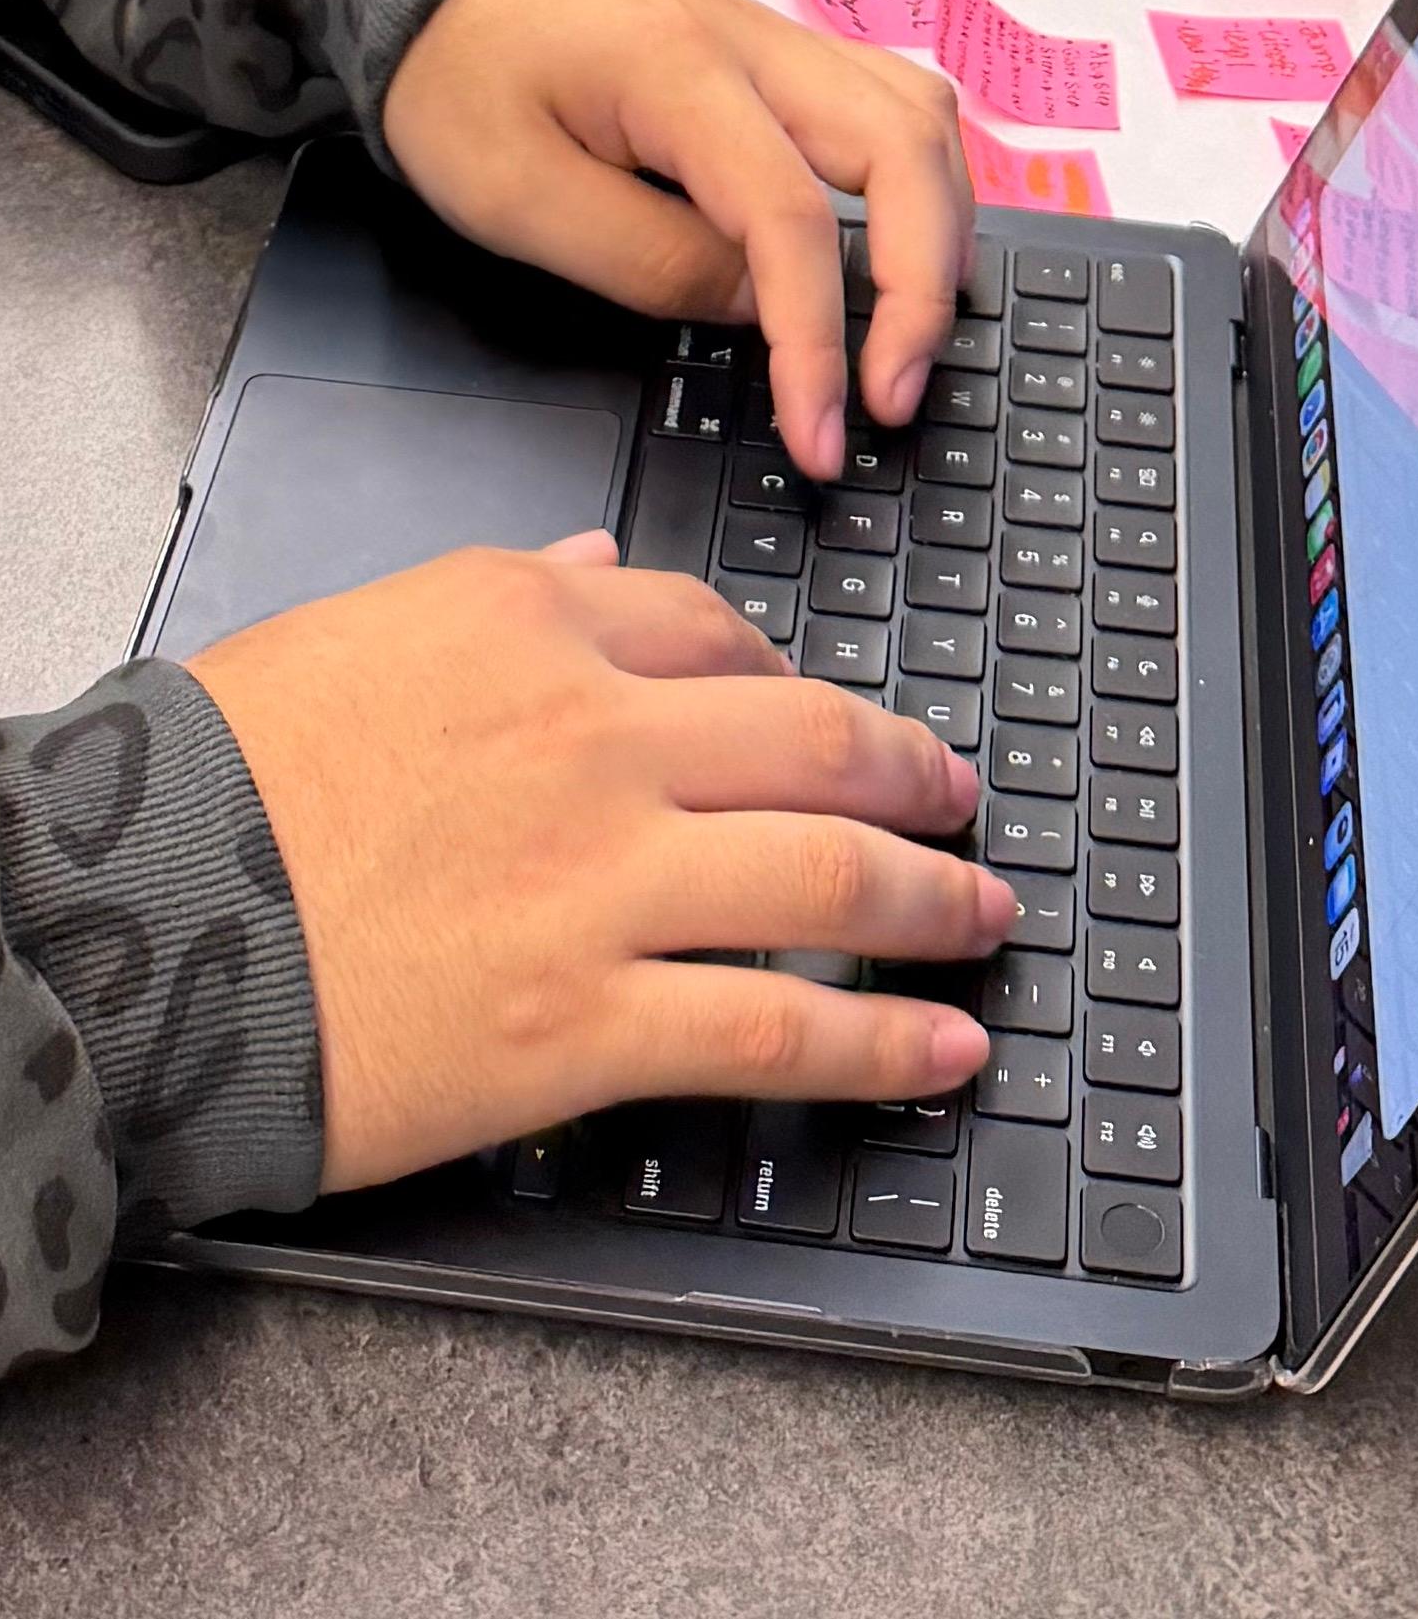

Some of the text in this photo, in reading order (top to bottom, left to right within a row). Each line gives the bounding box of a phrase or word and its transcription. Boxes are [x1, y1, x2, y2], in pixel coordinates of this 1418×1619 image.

[954, 337, 976, 349] Q
[1024, 373, 1047, 385] 2
[951, 390, 972, 408] W
[1022, 429, 1045, 442] 3
[856, 454, 878, 468] D
[945, 450, 969, 464] E
[761, 474, 785, 488] C
[1020, 488, 1042, 502] 4
[849, 515, 872, 529] F
[942, 510, 965, 523] R
[753, 536, 776, 551] V
[1017, 550, 1040, 564] 5
[842, 577, 866, 592] G
[937, 573, 961, 588] T
[744, 600, 768, 614] B
[1014, 613, 1038, 628] 6
[835, 642, 859, 659] H
[932, 638, 955, 652] Y
[1011, 682, 1035, 696] 7
[927, 705, 951, 721] U
[1106, 725, 1118, 740] F7
[1007, 750, 1032, 766] 8
[1004, 823, 1029, 839] 9
[1104, 872, 1117, 889] F9
[1335, 930, 1349, 967] 15
[1102, 950, 1116, 971] F10
[1101, 1033, 1115, 1054] F11
[1033, 1072, 1052, 1088] +
[1100, 1121, 1114, 1143] F12
[640, 1158, 662, 1198] shift
[754, 1160, 774, 1212] return
[983, 1187, 1004, 1240] delete
